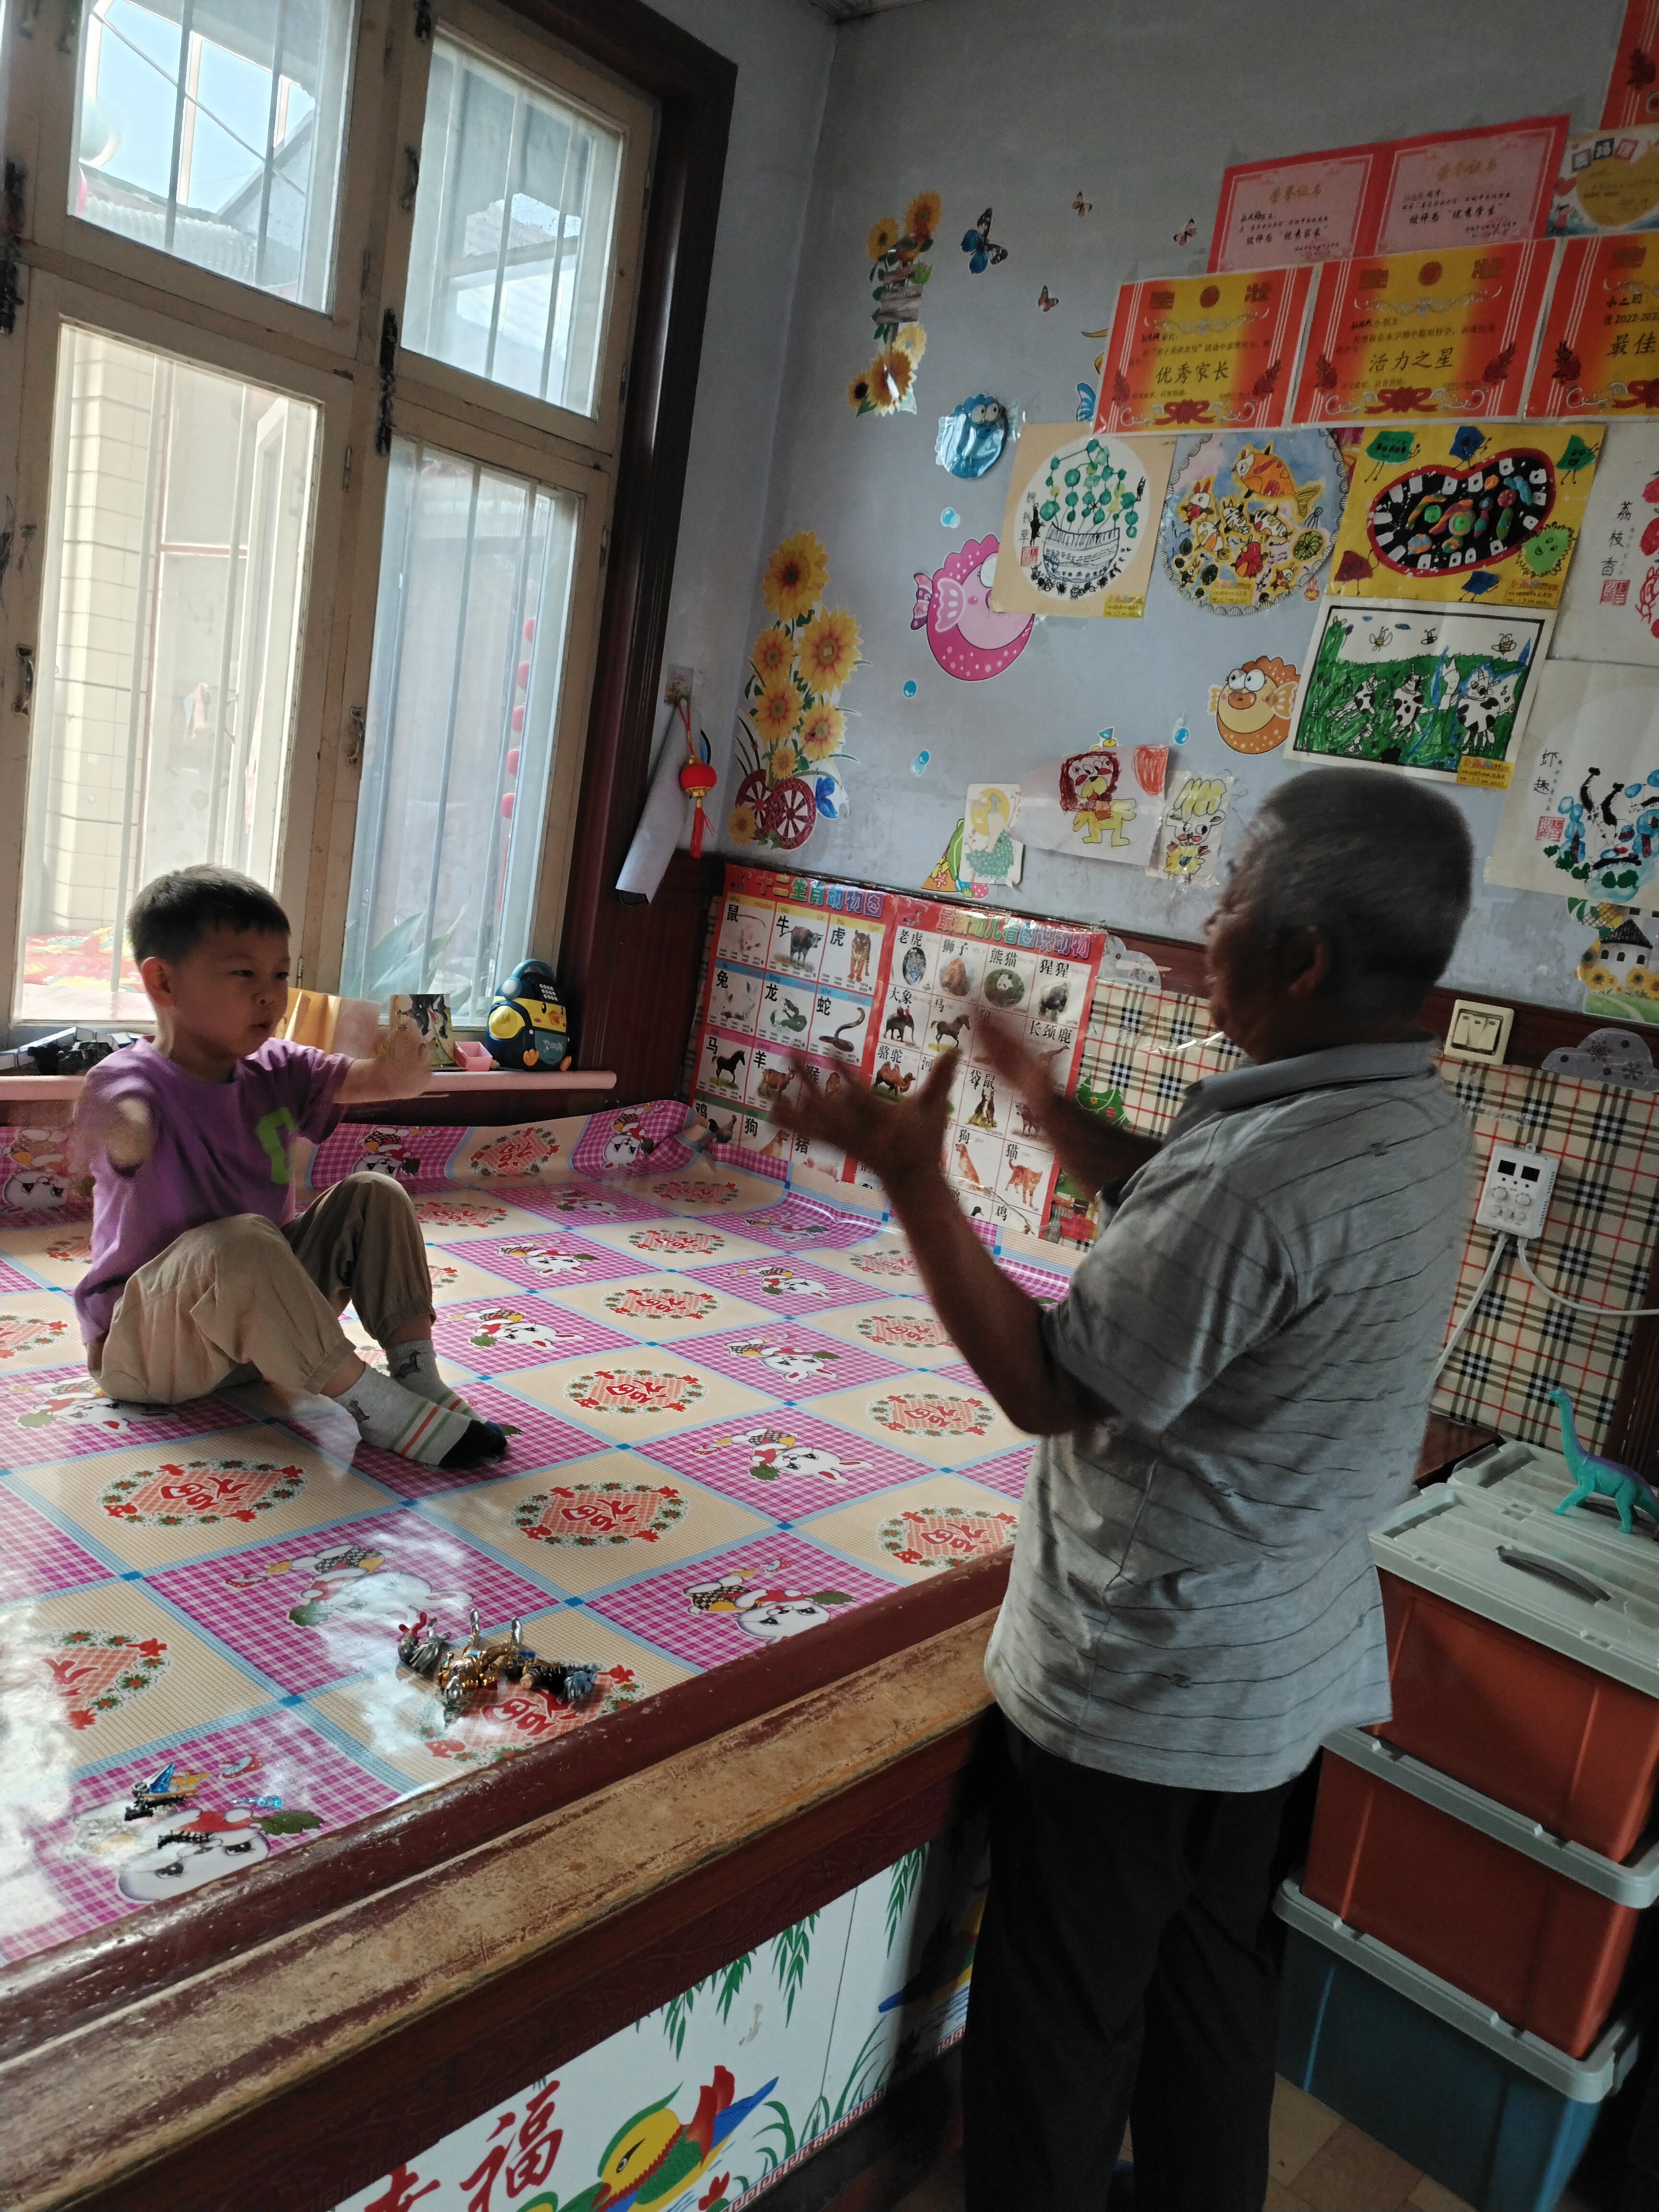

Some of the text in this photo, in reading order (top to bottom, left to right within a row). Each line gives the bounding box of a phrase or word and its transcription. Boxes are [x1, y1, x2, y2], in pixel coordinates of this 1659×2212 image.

[1606, 331, 1657, 357] 最佳
[1368, 348, 1455, 372] 活力之星
[1156, 361, 1229, 384] 优秀家长
[1601, 501, 1633, 577] 荔枝香
[1533, 748, 1559, 794] 虾趣
[757, 871, 885, 917] 十二生肖动物图
[727, 904, 739, 922] 鼠
[776, 915, 789, 935] 牛
[938, 904, 1091, 959] 最新幼儿看图识动物
[830, 927, 845, 946] 虎
[898, 929, 923, 947] 老虎
[989, 948, 1018, 967] 熊猫
[1039, 959, 1069, 978] 猩猩
[716, 970, 728, 988] 兔
[765, 983, 779, 1002] 龙
[889, 987, 912, 1004] 大象
[816, 996, 831, 1016] 蛇
[933, 997, 944, 1012] 马
[1030, 1020, 1072, 1044] 长颈鹿
[706, 1036, 718, 1055] 马
[878, 1046, 903, 1063] 骆驼
[754, 1050, 766, 1068] 羊
[805, 1064, 820, 1085] 猴
[969, 1070, 995, 1090] 袋鼠
[696, 1103, 708, 1119] 鸡
[745, 1118, 758, 1137] 狗
[958, 1129, 970, 1144] 狗
[795, 1135, 810, 1154] 猪
[1006, 1144, 1019, 1159] 猫
[498, 1142, 533, 1168] 福
[995, 1205, 1008, 1221] 鸡
[636, 1297, 686, 1314] 福
[886, 1324, 935, 1341] 福
[606, 1380, 668, 1403] 福
[904, 1404, 963, 1428] 福
[160, 1477, 253, 1510] 福
[562, 1498, 640, 1531] 福
[922, 1524, 990, 1552] 福
